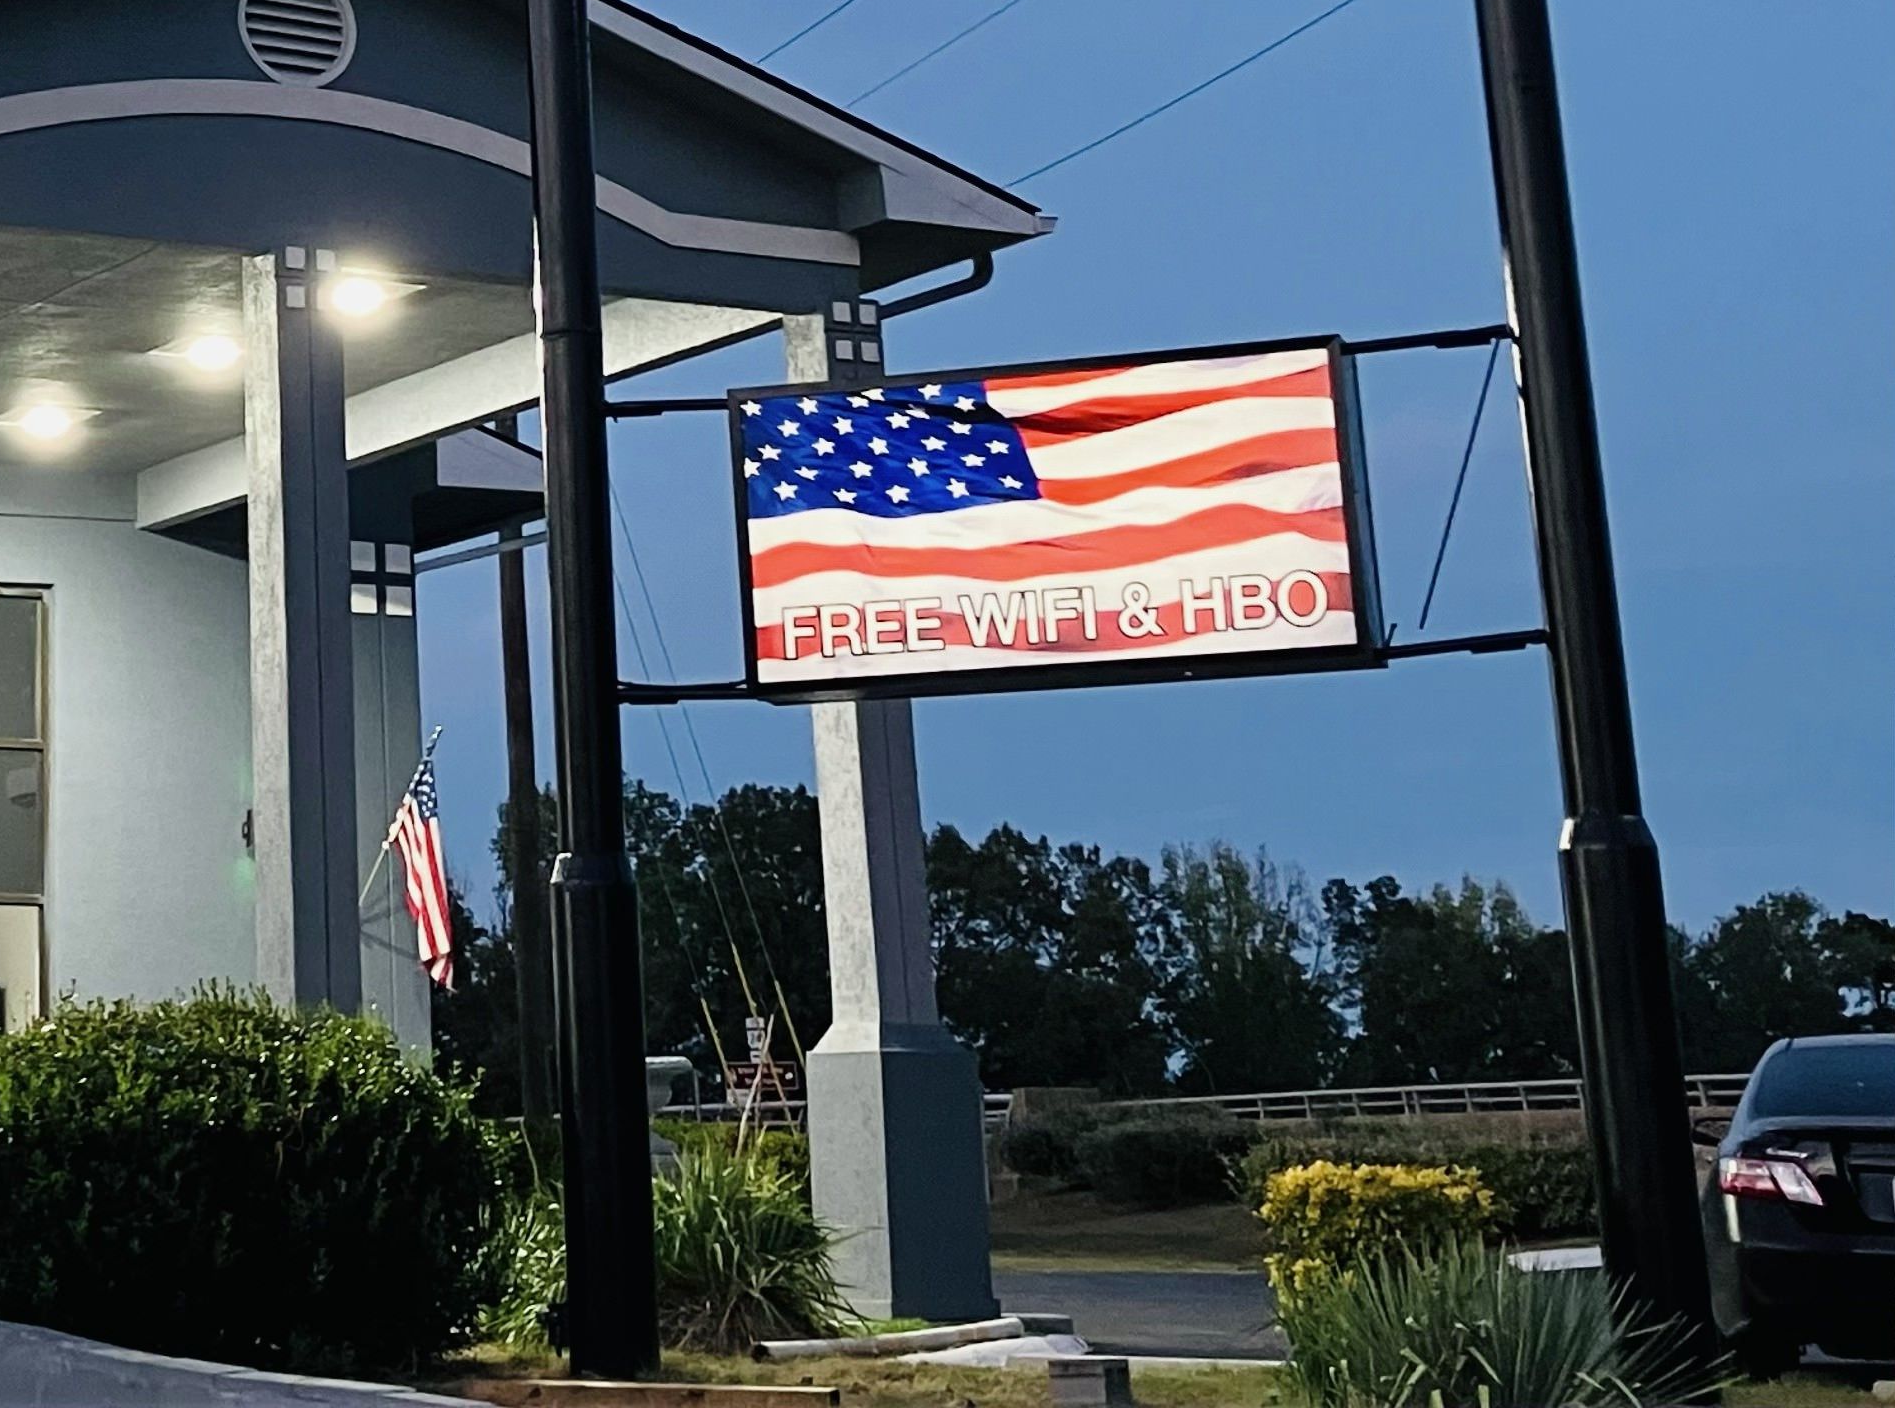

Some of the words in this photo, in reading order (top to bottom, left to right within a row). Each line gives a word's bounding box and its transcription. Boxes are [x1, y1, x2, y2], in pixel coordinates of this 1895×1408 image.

[782, 596, 946, 659] FREE
[958, 586, 1098, 647] WIFI
[1117, 581, 1167, 639] &
[1179, 569, 1328, 635] HBO
